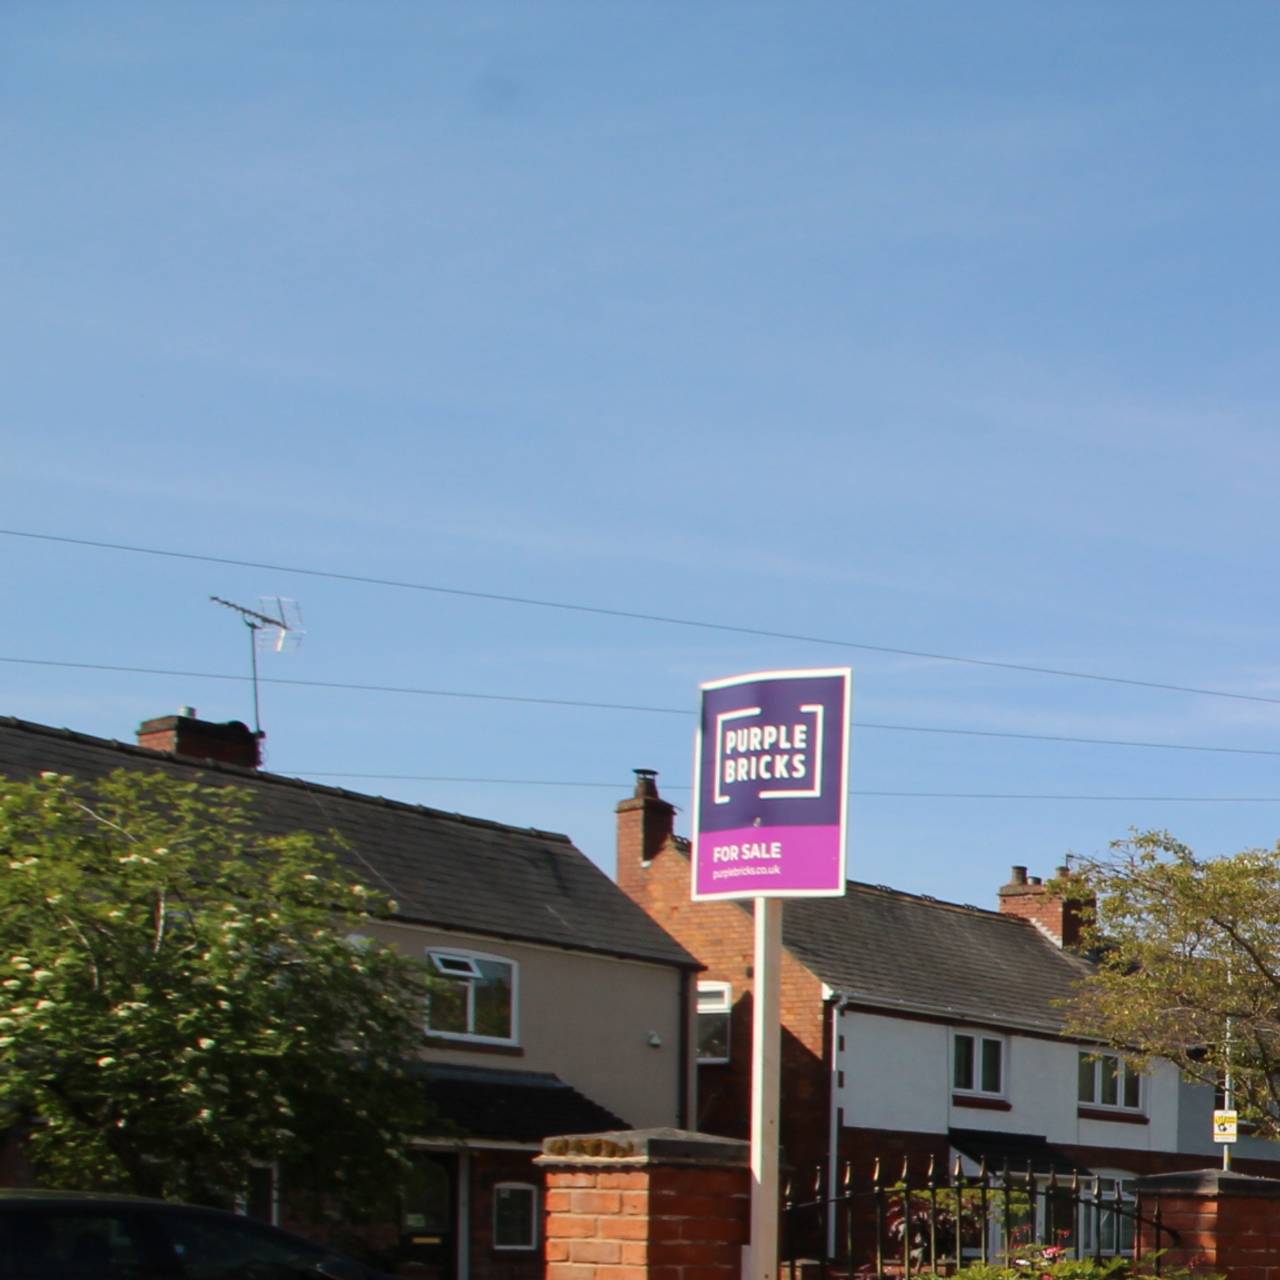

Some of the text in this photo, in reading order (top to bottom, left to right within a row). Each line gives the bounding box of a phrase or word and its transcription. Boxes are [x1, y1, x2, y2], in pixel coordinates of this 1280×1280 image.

[725, 725, 807, 755] PURPLE
[724, 754, 807, 784] BRICKS
[713, 842, 782, 863] FOR SALE
